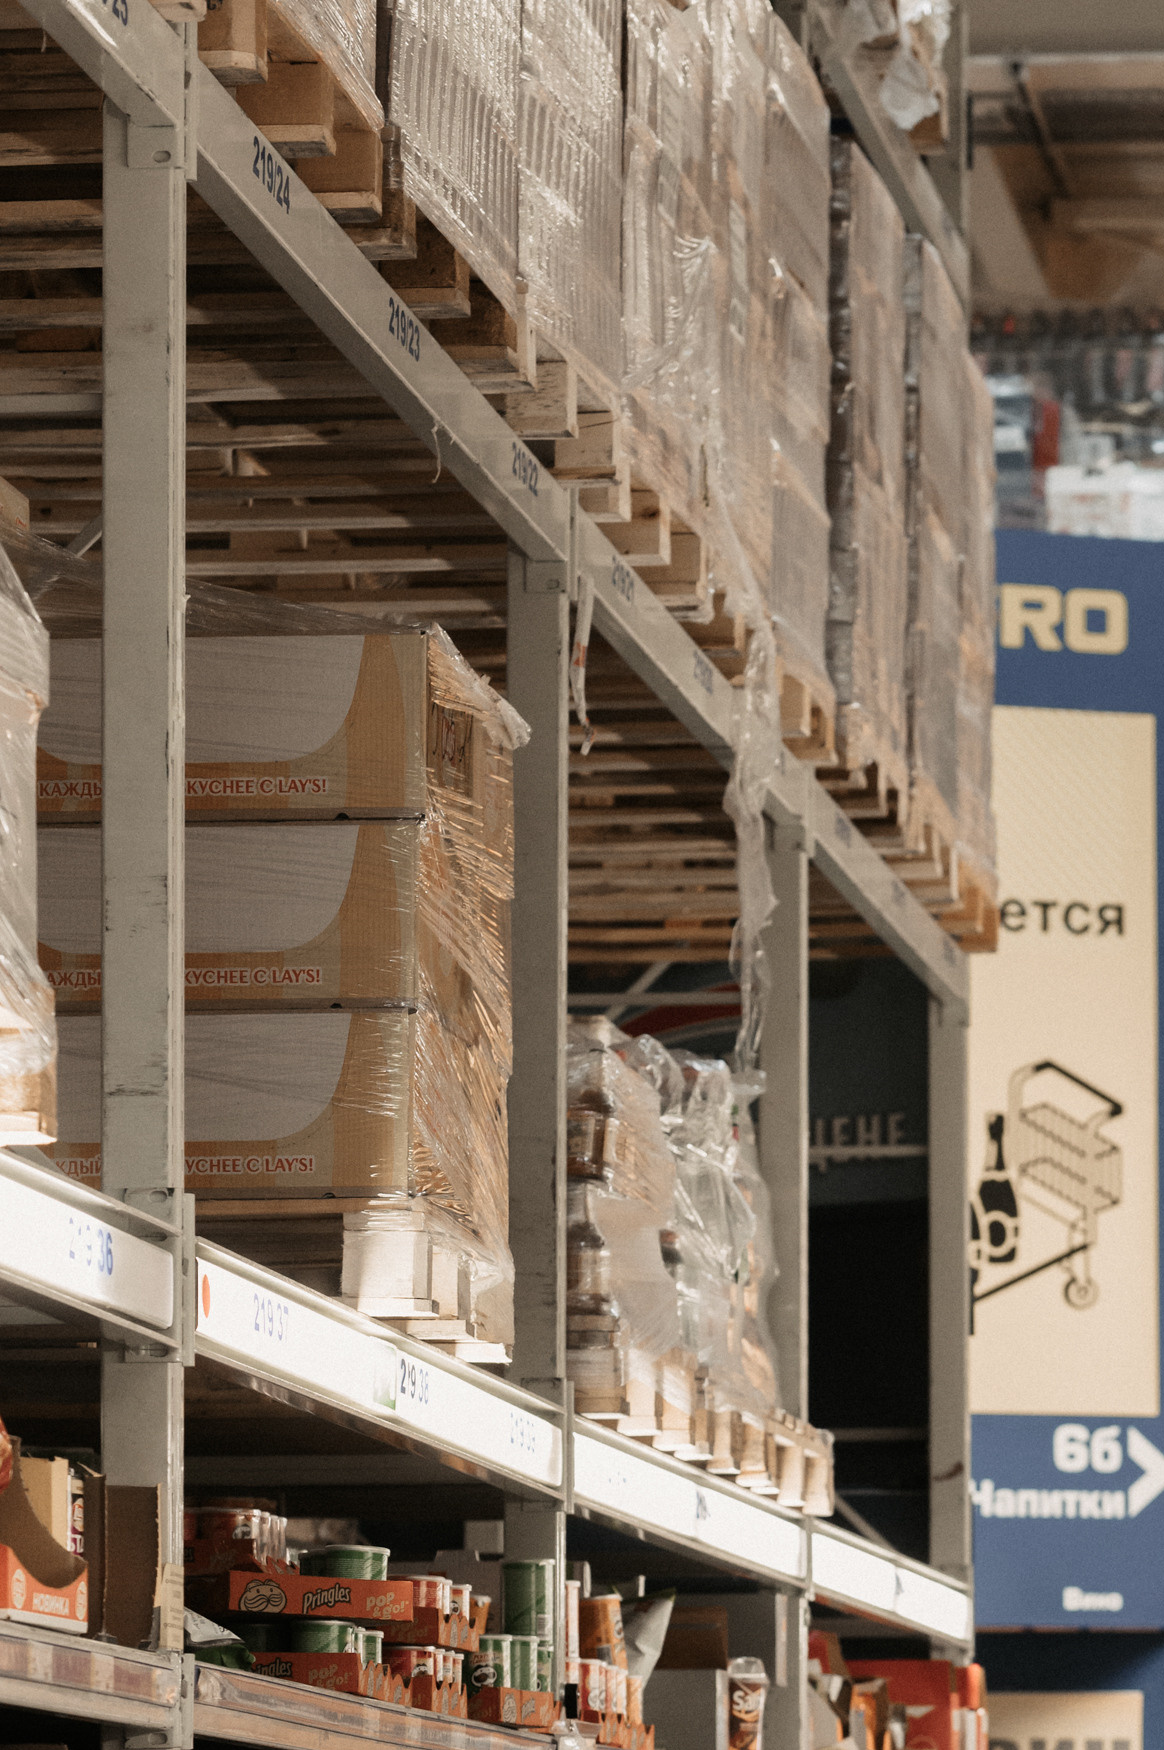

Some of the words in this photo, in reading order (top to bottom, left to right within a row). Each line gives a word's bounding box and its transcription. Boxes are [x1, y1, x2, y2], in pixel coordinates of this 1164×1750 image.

[252, 136, 290, 214] 219/24
[388, 297, 421, 362] 219/23
[511, 441, 539, 497] 219/22
[999, 576, 1129, 655] RO
[278, 778, 327, 794] LAY'S!
[1000, 898, 1124, 936] ется
[272, 968, 321, 983] LAY'S!
[265, 1157, 314, 1172] LAY'S!
[302, 1583, 351, 1614] Pringles
